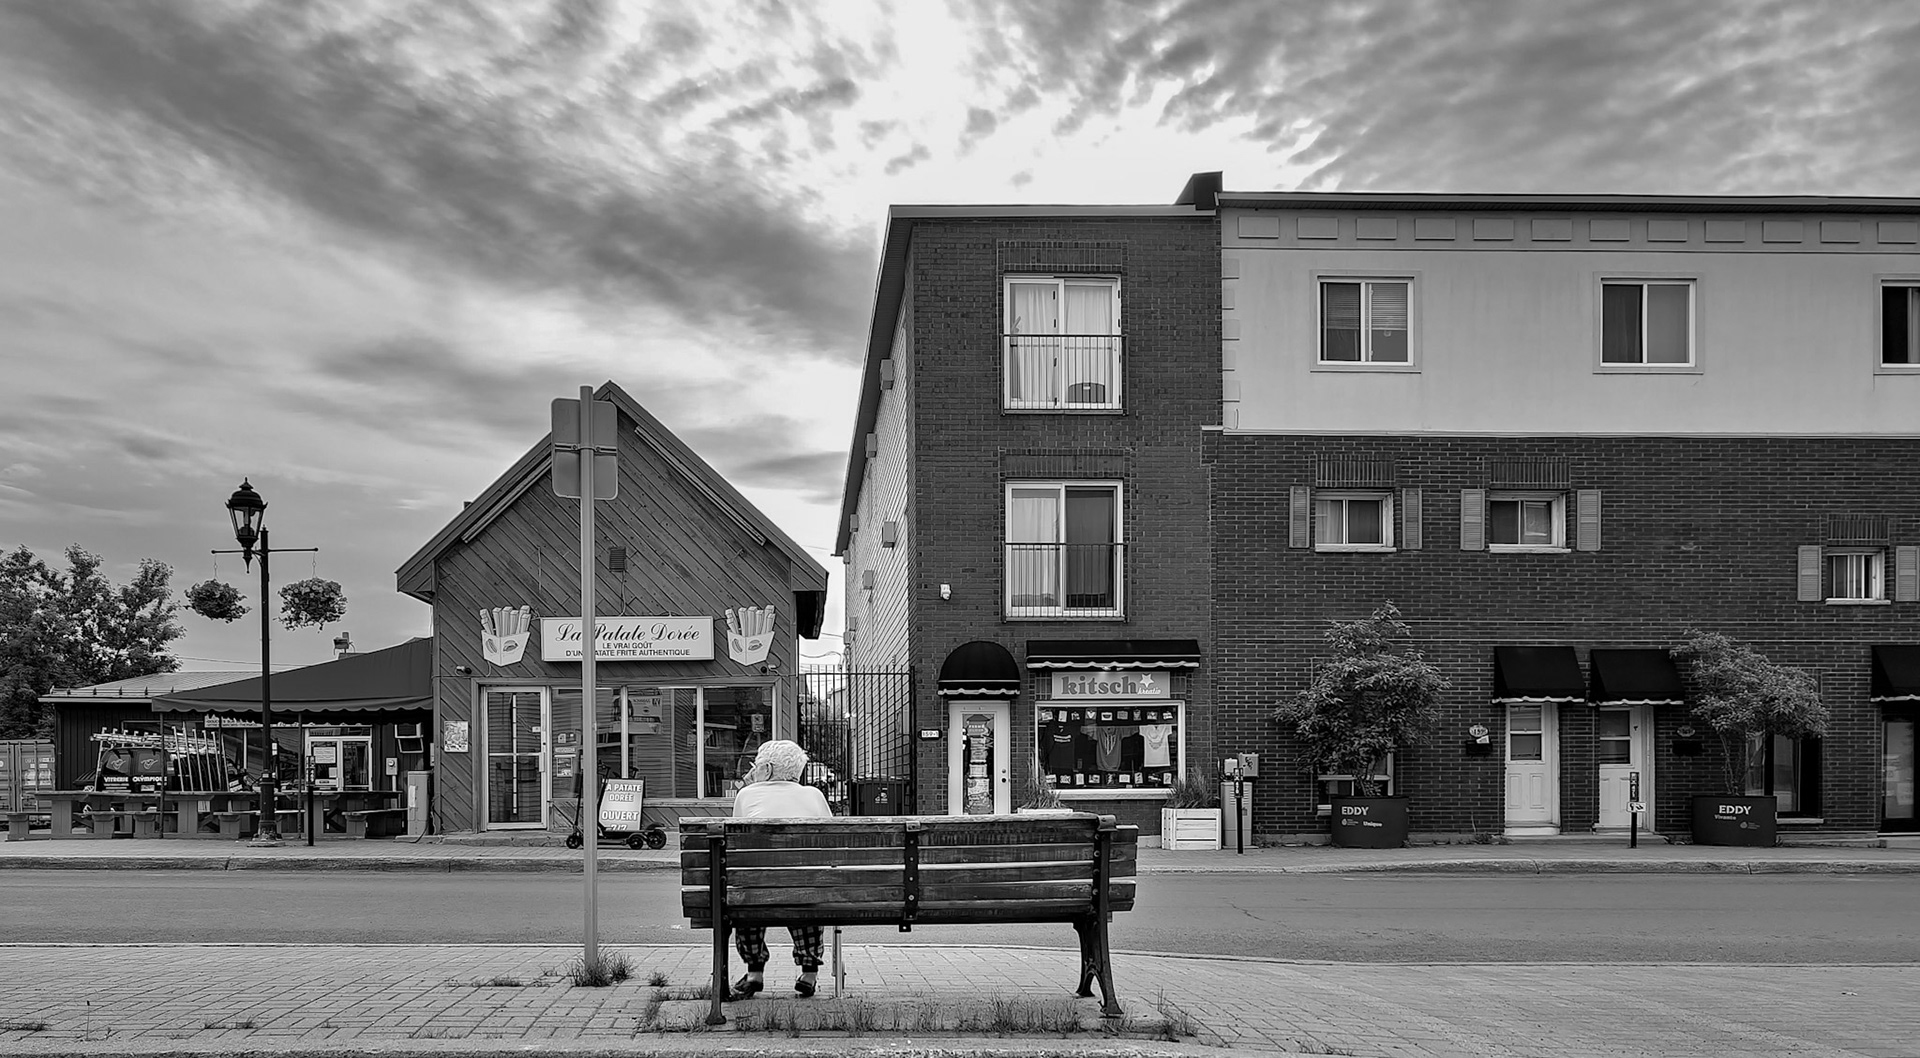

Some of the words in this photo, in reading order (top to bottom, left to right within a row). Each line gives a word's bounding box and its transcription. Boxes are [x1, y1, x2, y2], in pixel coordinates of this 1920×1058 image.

[555, 623, 582, 641] La
[594, 622, 646, 641] Patate
[650, 622, 700, 641] Dorée
[632, 641, 653, 650] GOÛT
[1061, 675, 1138, 695] kitsch
[614, 783, 642, 792] PATATE
[1341, 806, 1369, 815] EDDY
[1719, 805, 1751, 814] EDDY
[601, 810, 639, 821] OUVERT
